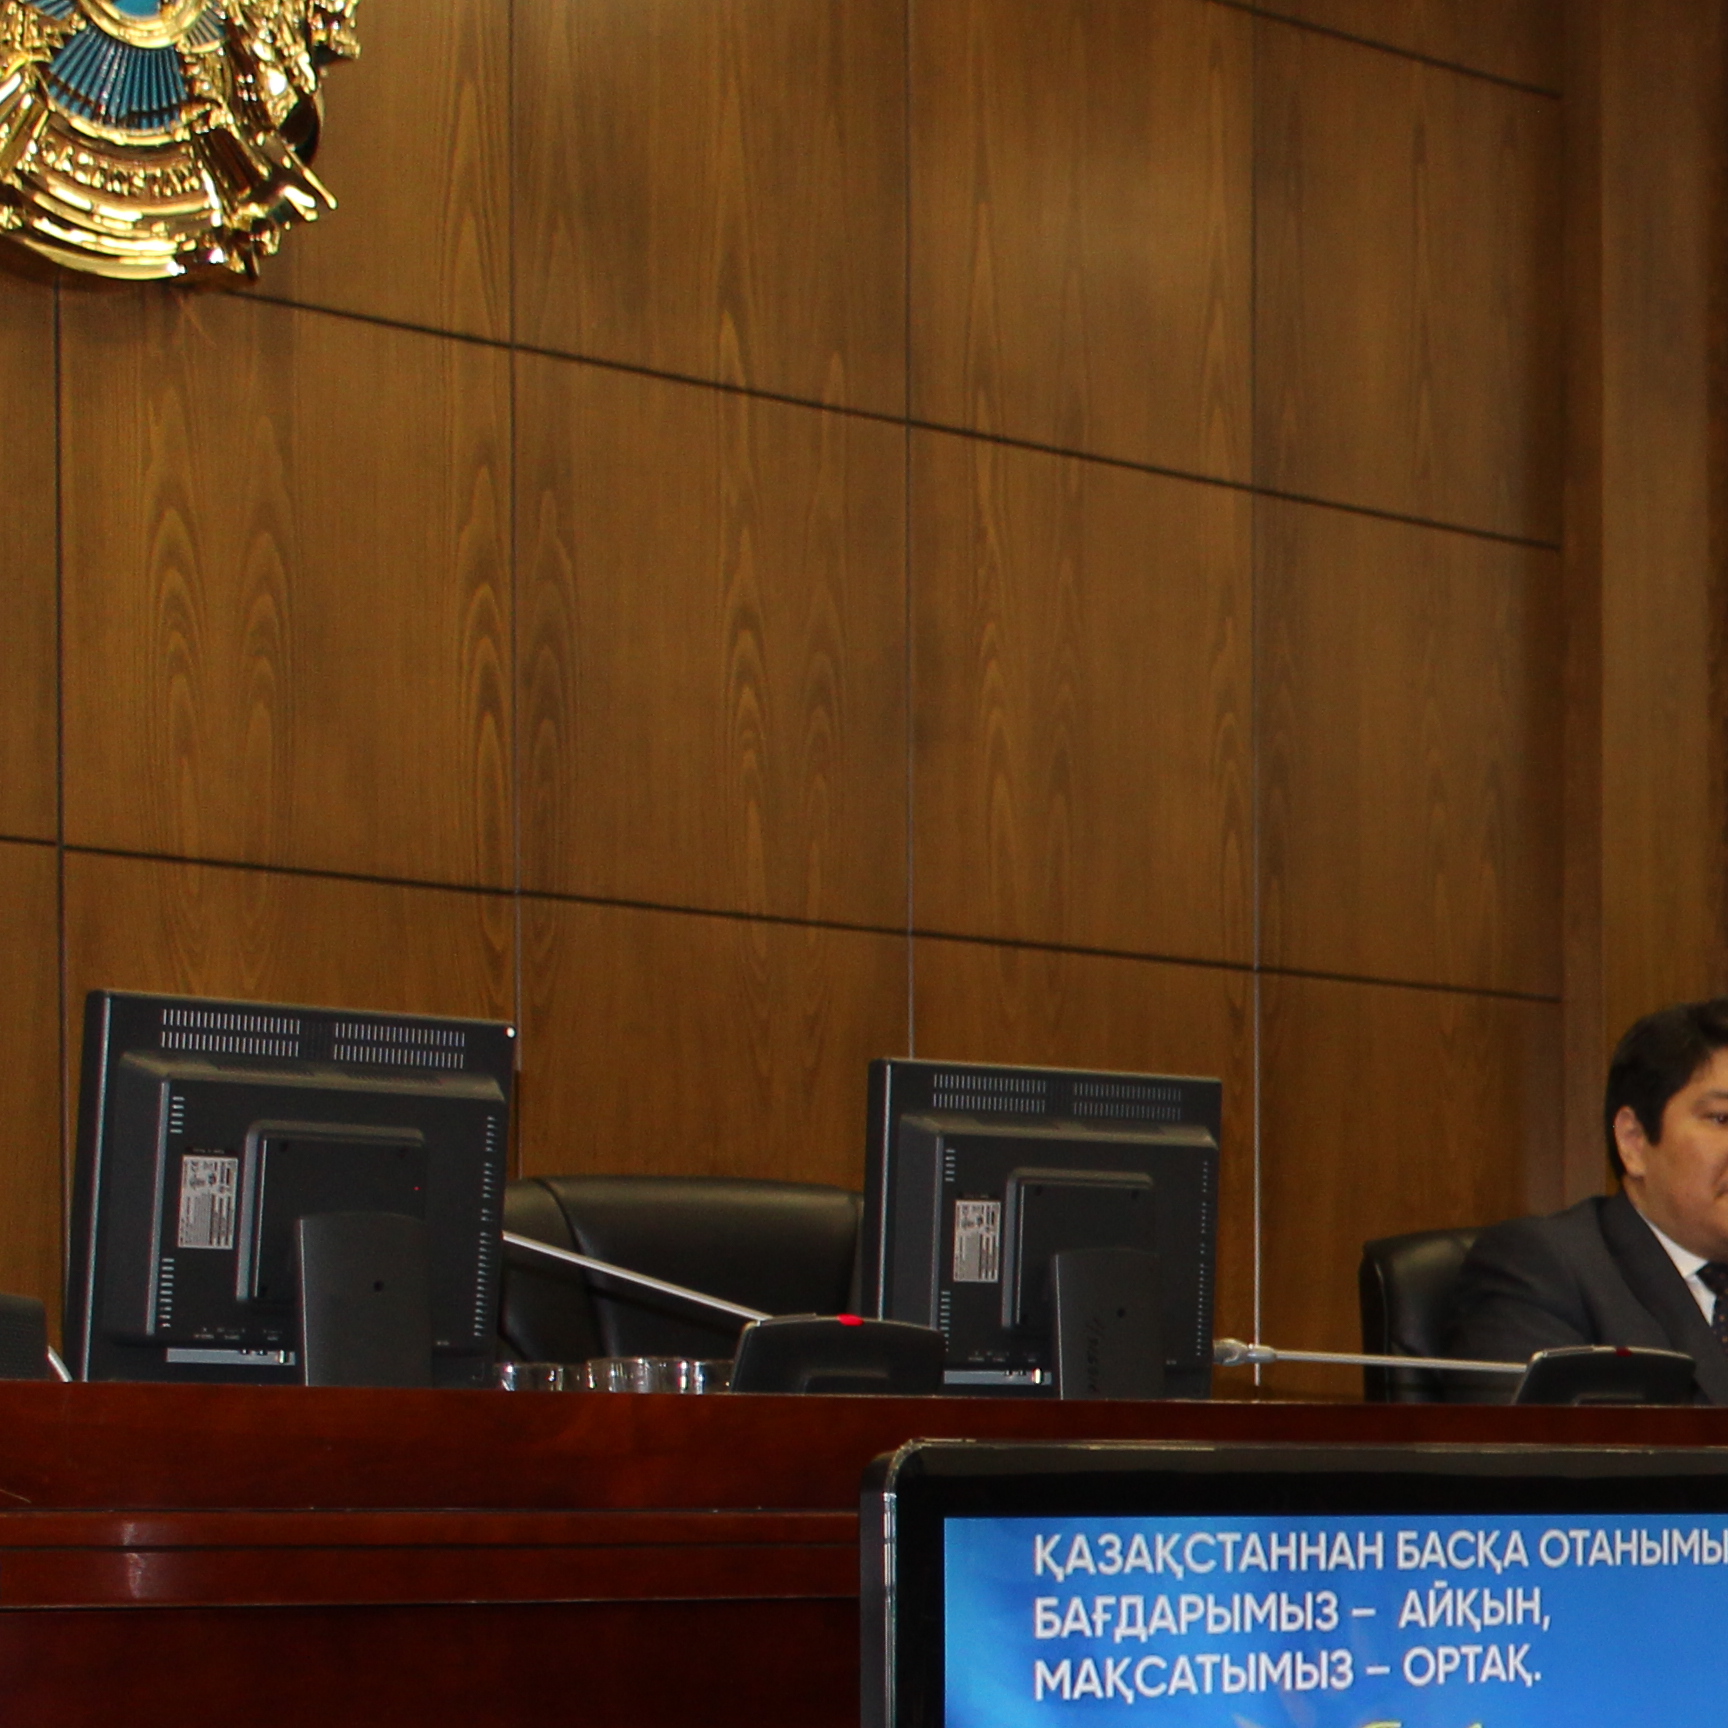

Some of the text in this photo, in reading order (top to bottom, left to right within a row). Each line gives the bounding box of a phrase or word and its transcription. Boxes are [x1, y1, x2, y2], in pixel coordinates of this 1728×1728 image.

[1034, 1532, 1384, 1583] ҚАЗАҚСТАННАН
[1397, 1530, 1529, 1575] БАСҚА
[1034, 1590, 1339, 1644] БАҒДАРЫМЫЗ
[1398, 1580, 1551, 1633] АЙҚЫН,
[1034, 1648, 1354, 1705] МАҚСАТЫМЫЗ
[1402, 1643, 1542, 1687] ОРТАҚ.
